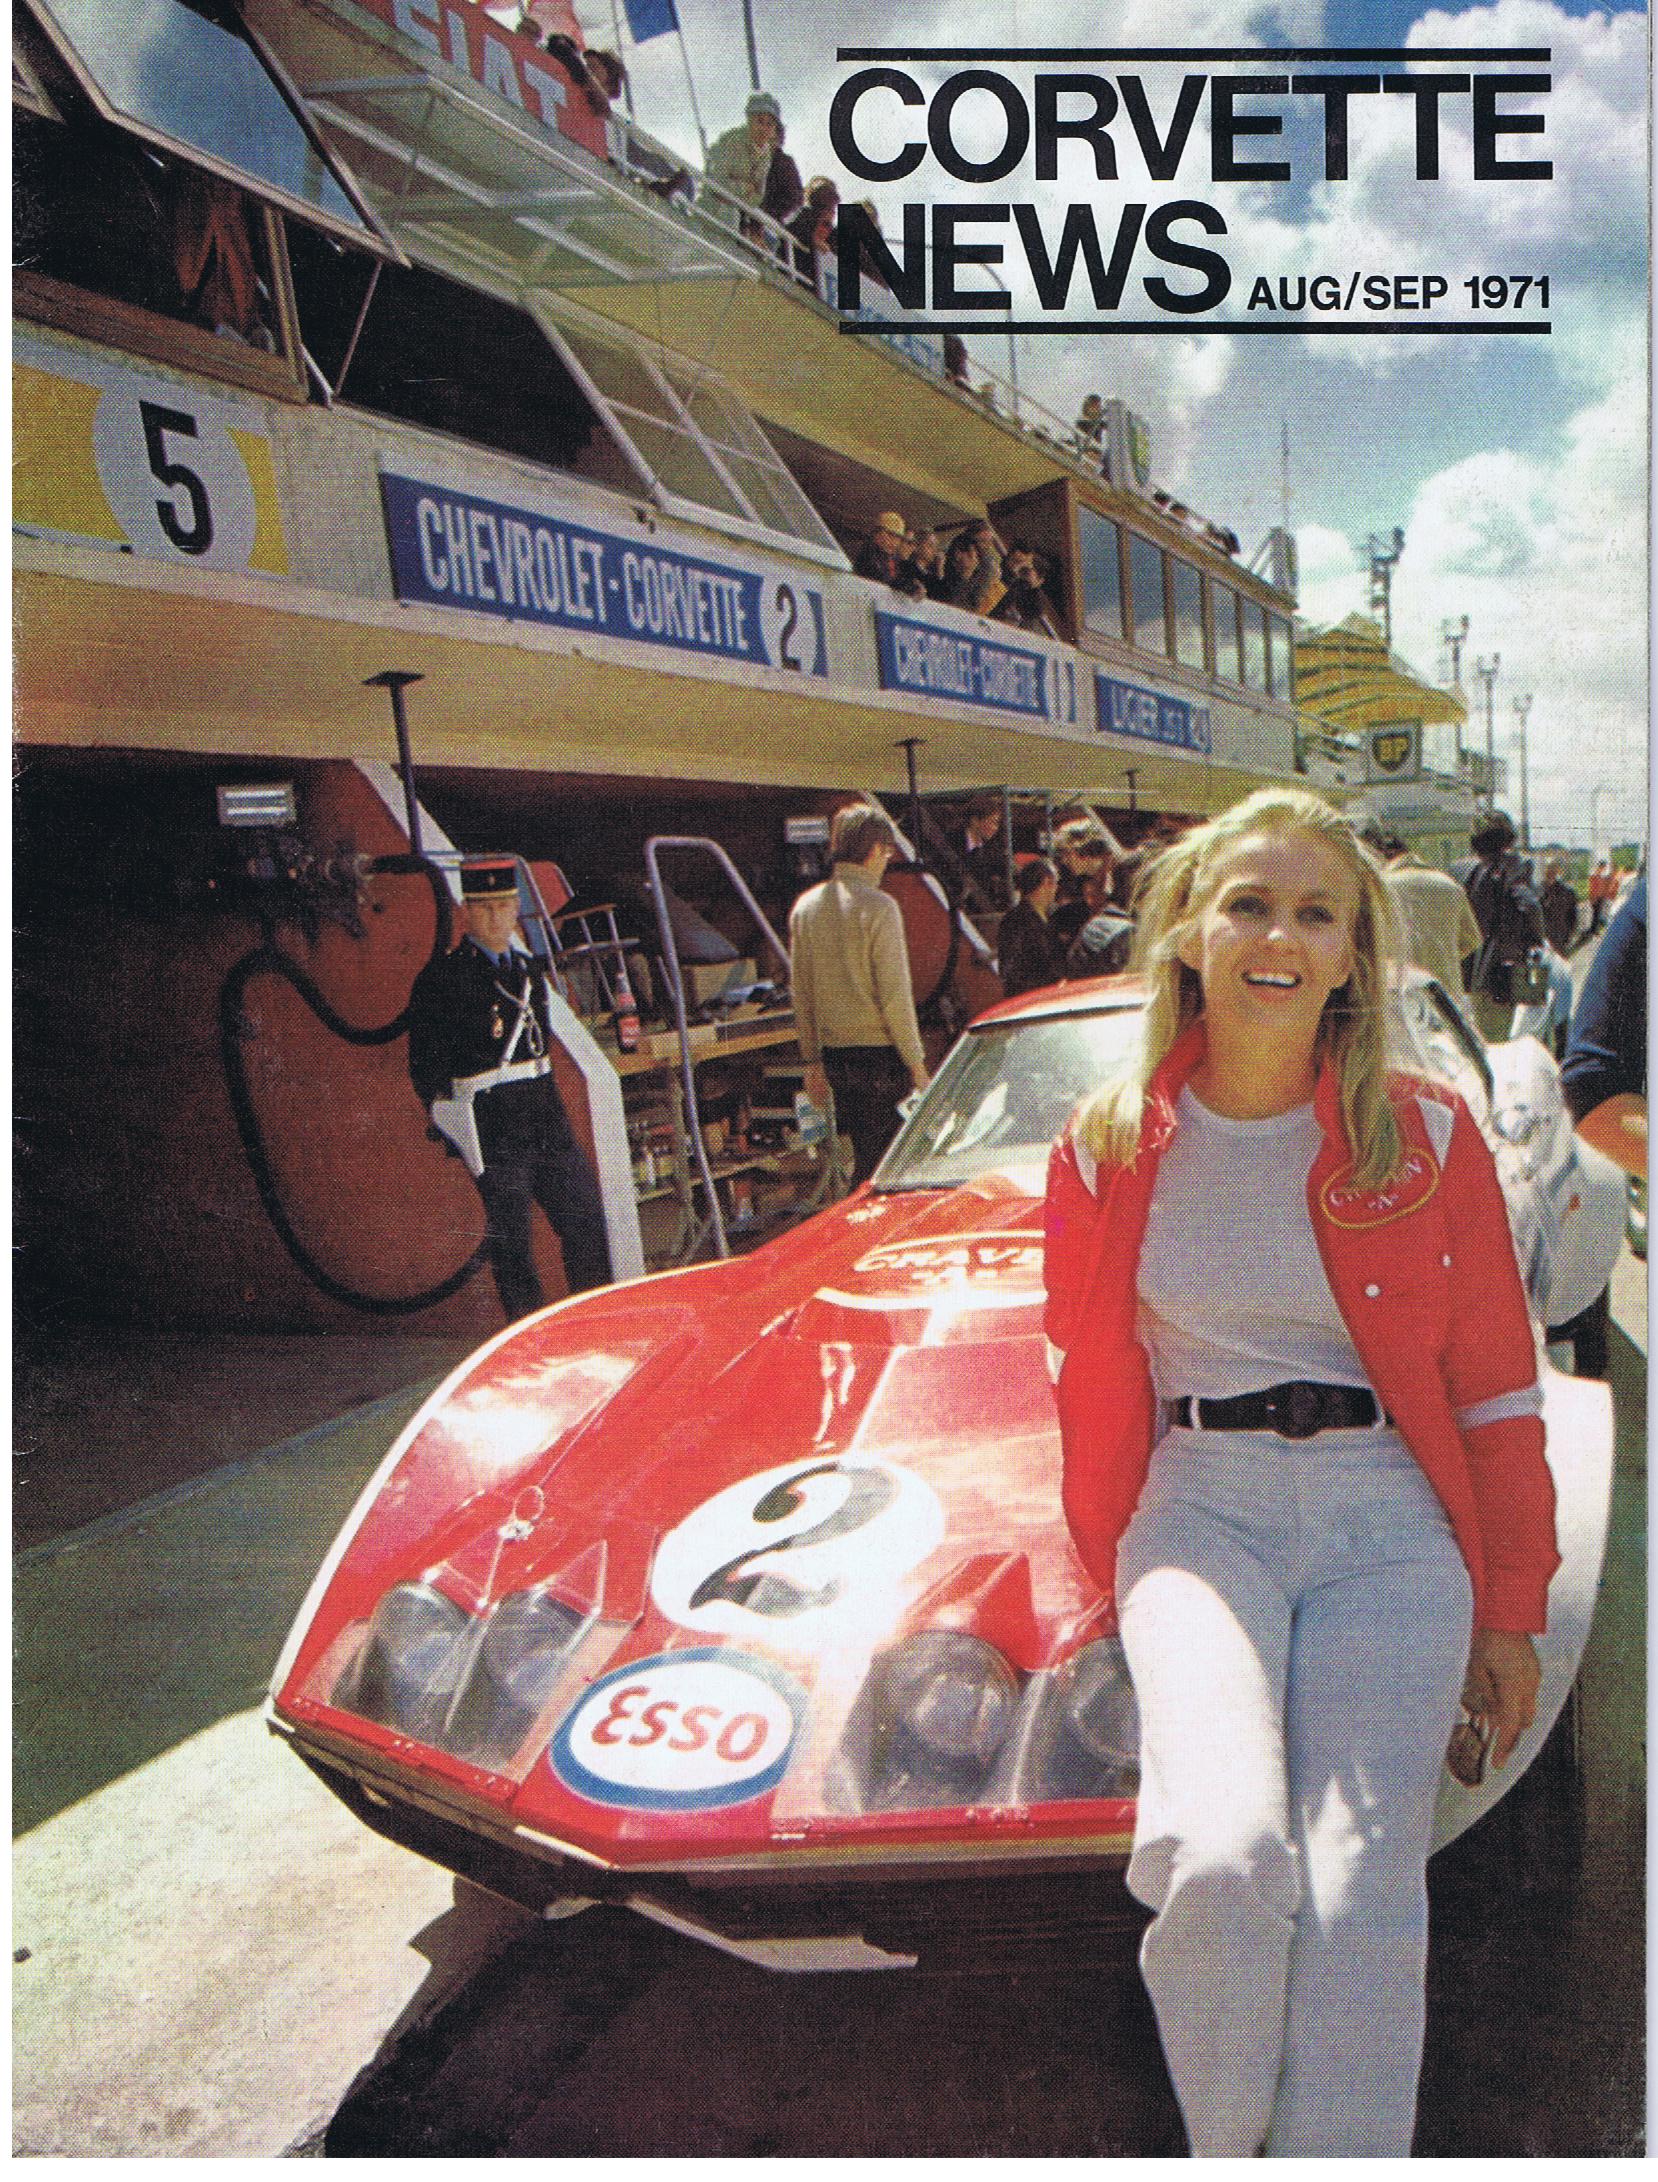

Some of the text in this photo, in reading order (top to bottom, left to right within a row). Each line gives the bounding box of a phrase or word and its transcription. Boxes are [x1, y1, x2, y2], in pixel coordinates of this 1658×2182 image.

[138, 399, 214, 556] 5
[776, 583, 801, 672] 2
[1379, 737, 1409, 762] BP
[689, 1461, 902, 1618] 2
